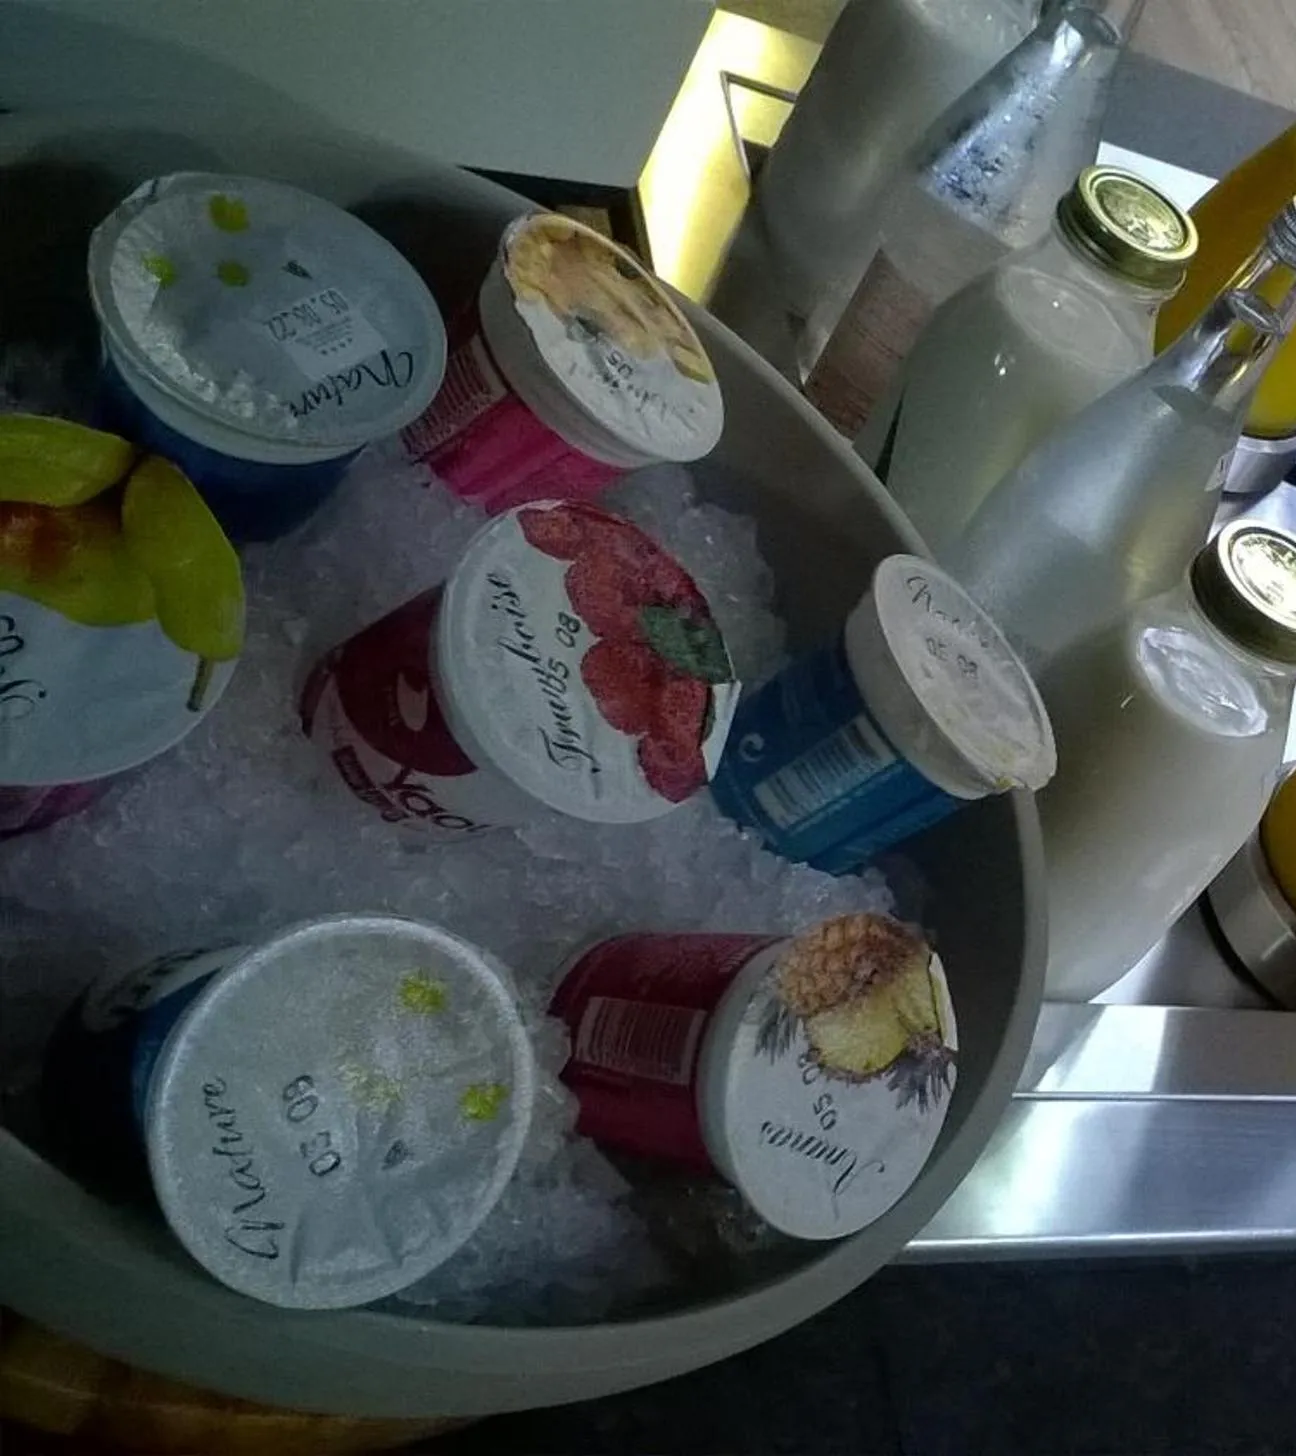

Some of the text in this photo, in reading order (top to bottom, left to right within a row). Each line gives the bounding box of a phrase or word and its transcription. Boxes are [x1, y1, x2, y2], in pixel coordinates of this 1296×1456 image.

[811, 1091, 838, 1132] 05
[202, 1076, 285, 1260] Nature
[759, 1119, 886, 1196] Ananas
